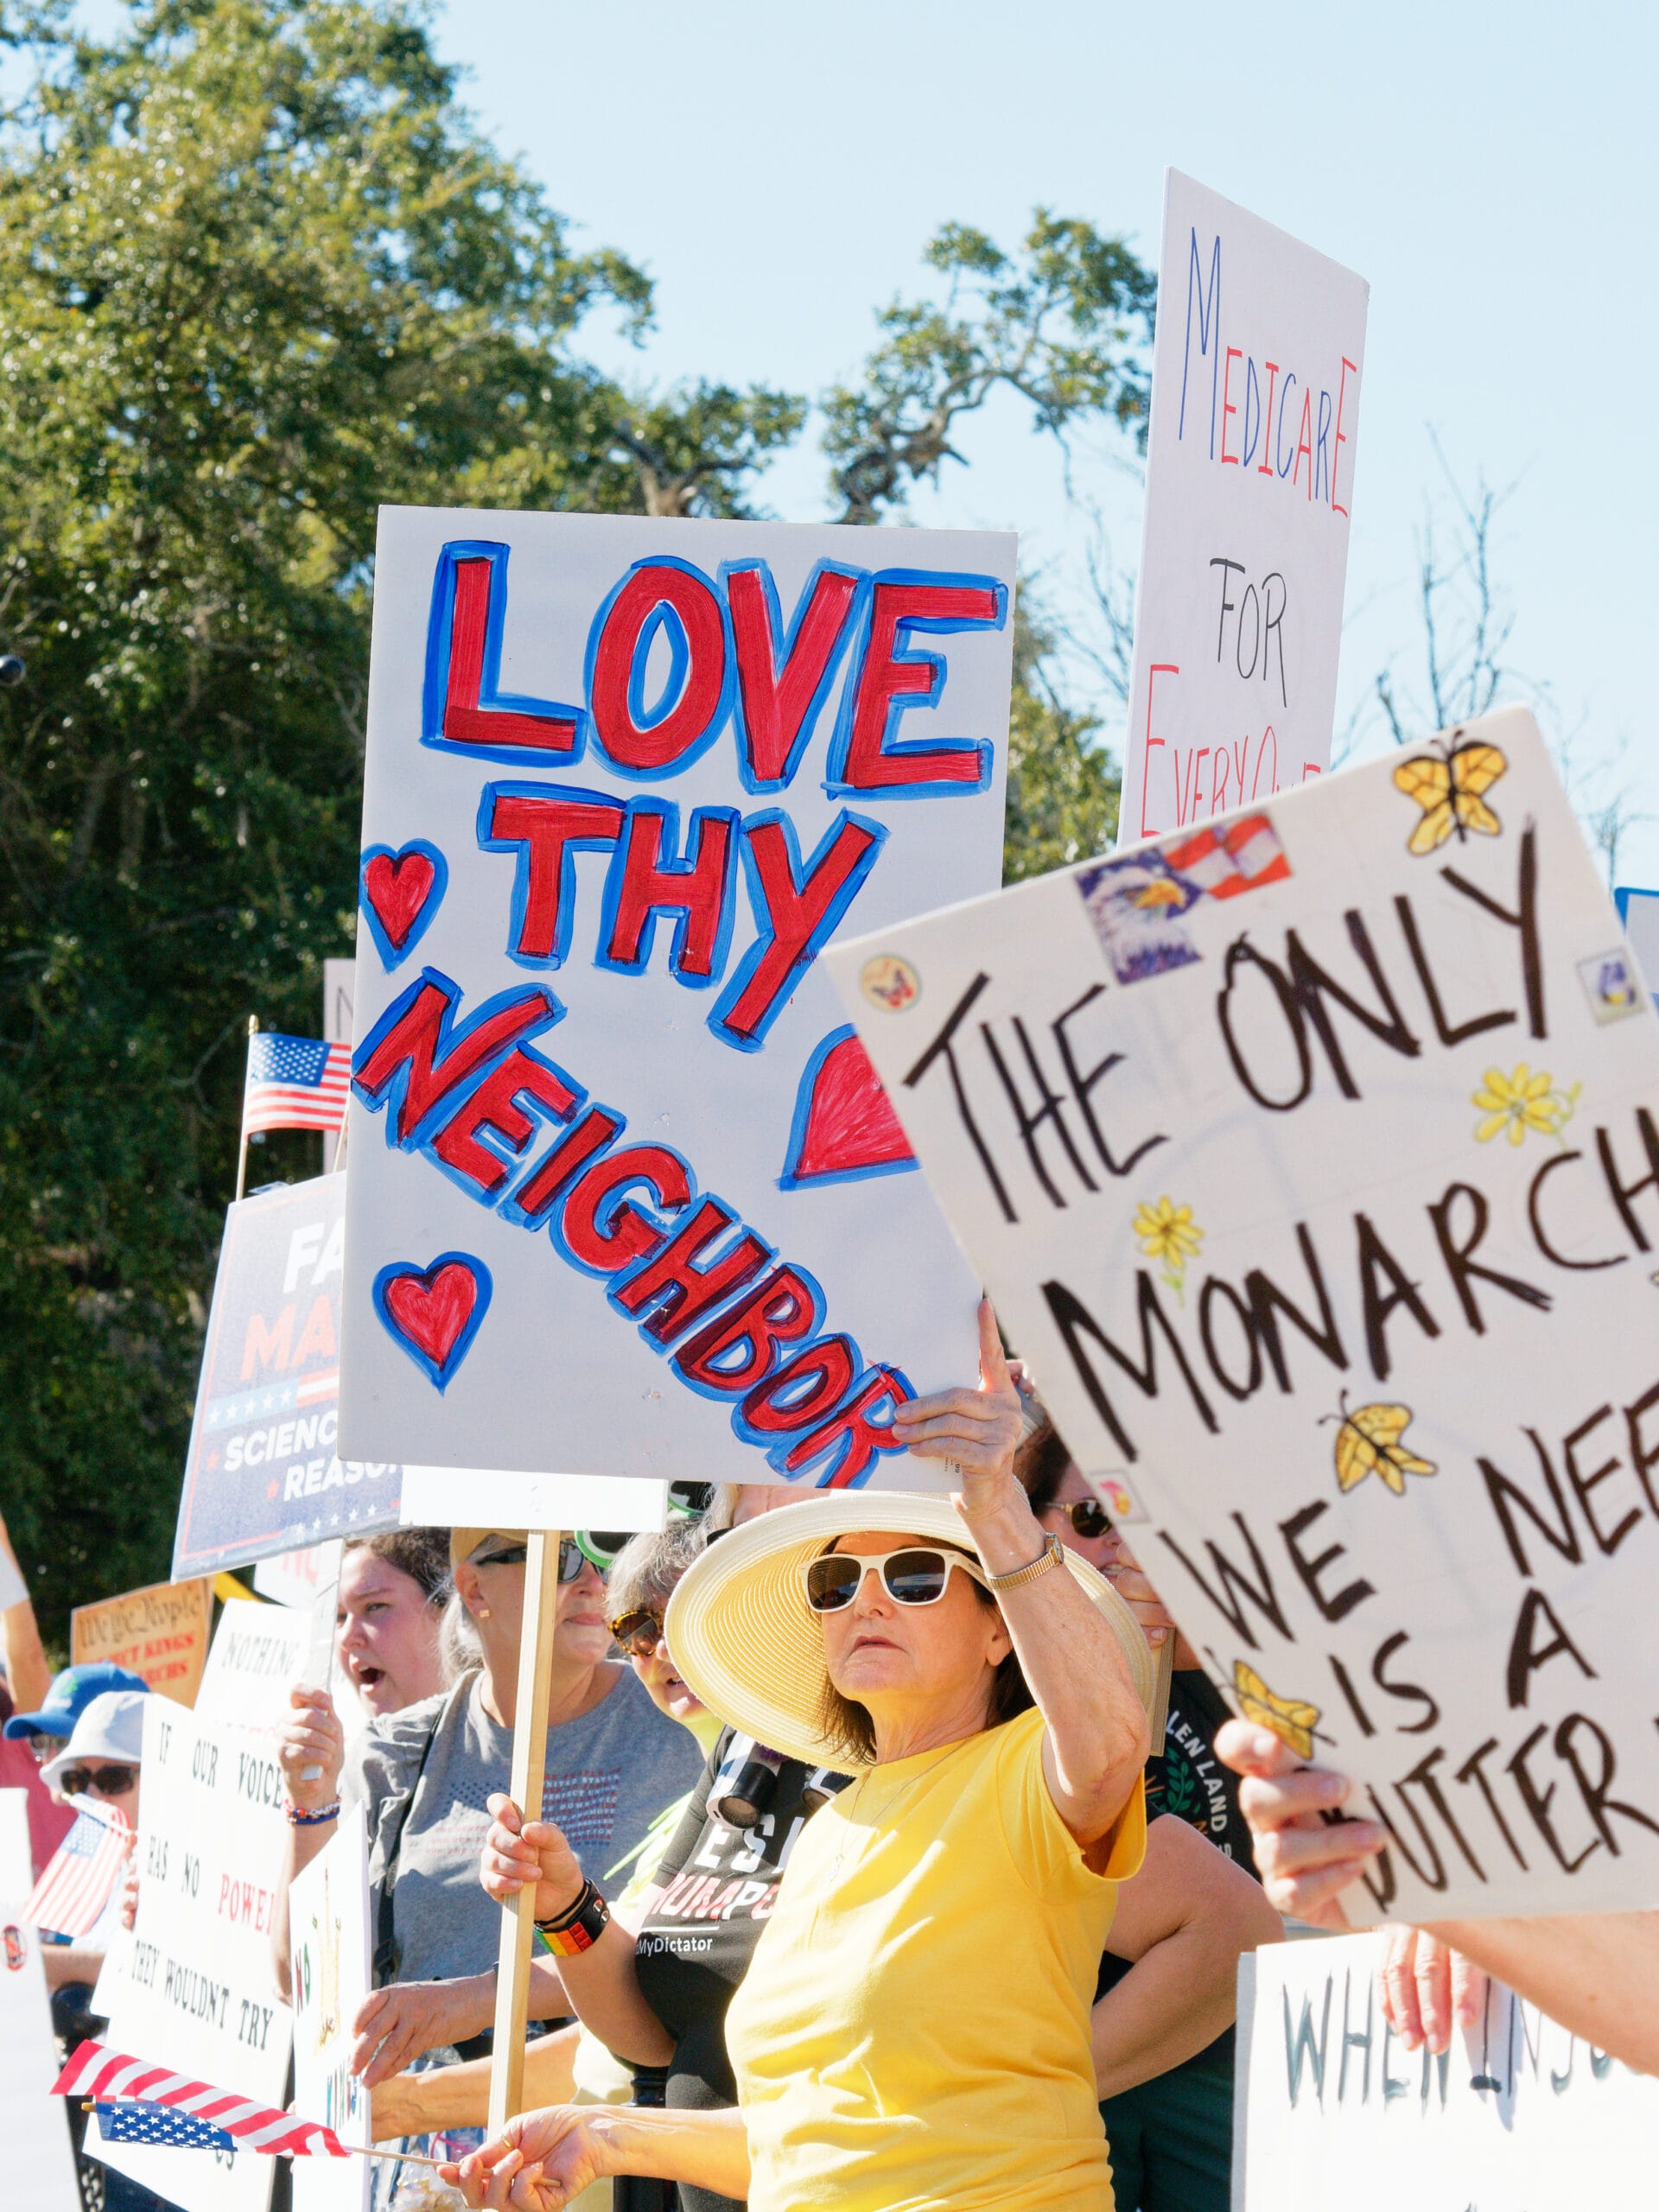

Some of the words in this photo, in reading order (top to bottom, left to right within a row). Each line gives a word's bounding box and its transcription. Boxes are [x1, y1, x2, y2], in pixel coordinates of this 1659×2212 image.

[1179, 226, 1357, 518] MEDICARE
[418, 540, 1008, 802] LOVE
[1210, 556, 1287, 708] FOR
[1141, 664, 1321, 839] EVERYO
[476, 779, 892, 1054] THY
[902, 972, 1171, 1224] THE
[1217, 815, 1549, 1113] ONLY
[351, 965, 920, 1489] NEIGHBOR
[1041, 1105, 1659, 1464] MONARCH
[240, 1294, 339, 1381] MA
[224, 1410, 338, 1471] SCIENC
[1157, 1499, 1378, 1651] WE
[1475, 1381, 1659, 1579] NEE
[1328, 1630, 1440, 1738] IS
[1506, 1587, 1599, 1710] A
[160, 1721, 172, 1764] IF
[193, 1738, 219, 1789] OUR
[1166, 1710, 1207, 1759] LEN
[1196, 1759, 1229, 1834] LAND
[1296, 1713, 1659, 1915] UTTER
[181, 1852, 200, 1898] NO
[636, 1936, 713, 1957] MyDictator
[131, 1939, 160, 1988] THEY
[238, 1998, 273, 2050] TRY
